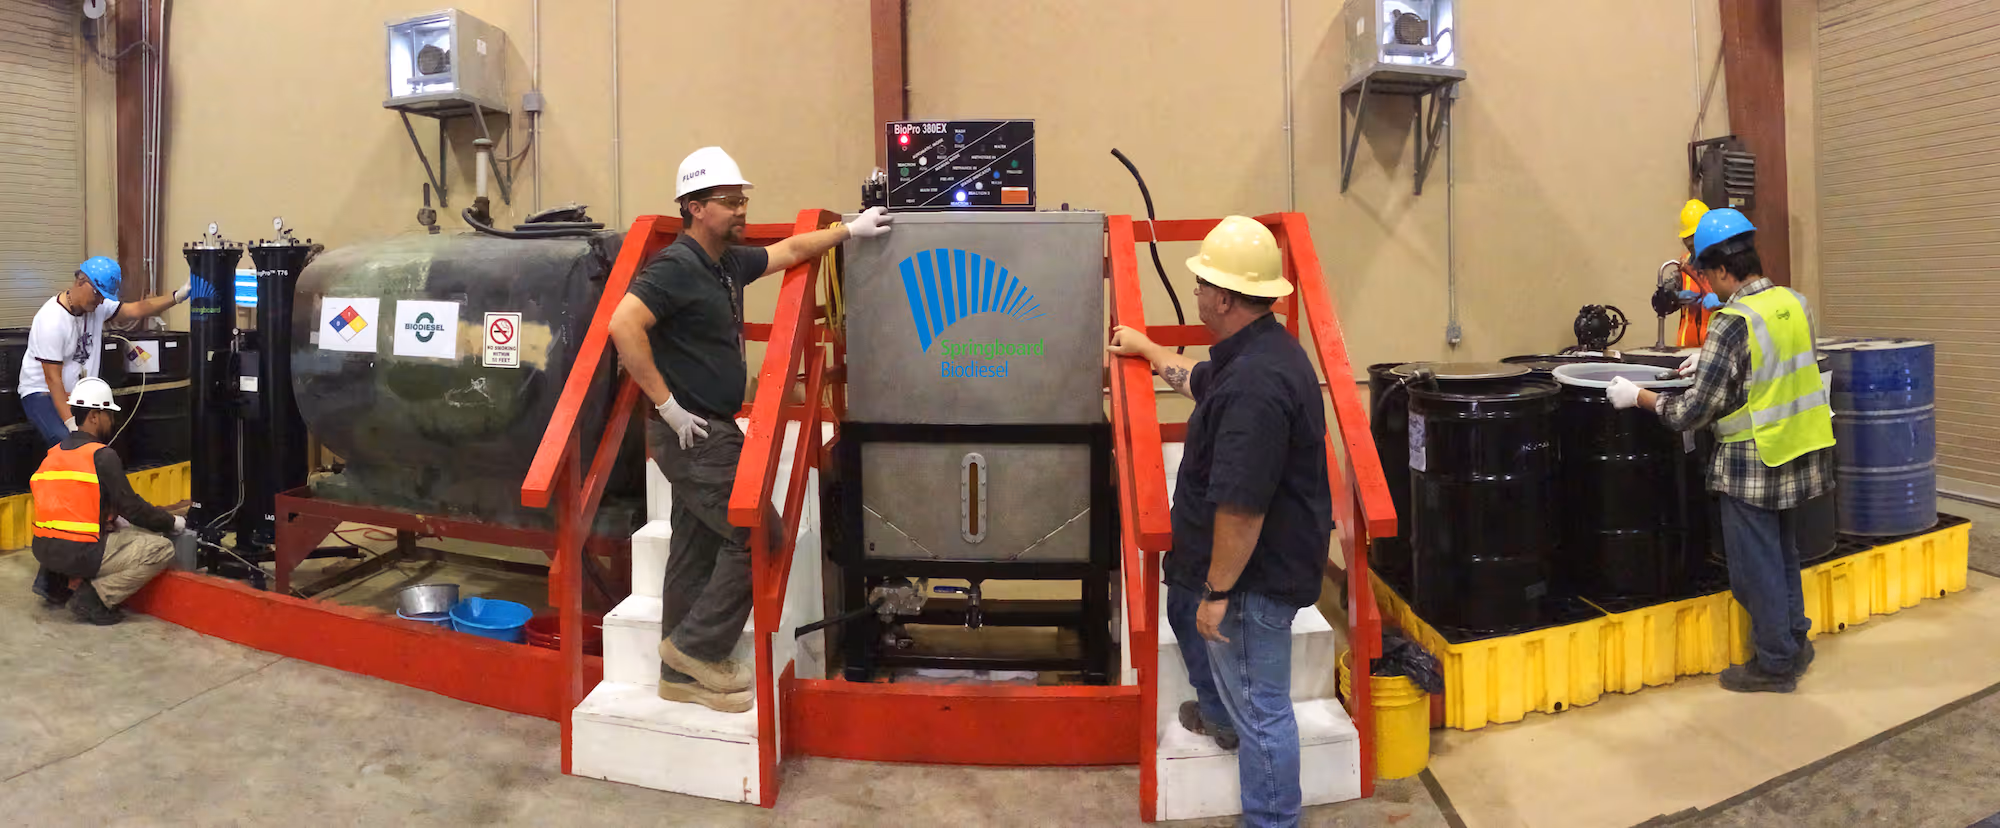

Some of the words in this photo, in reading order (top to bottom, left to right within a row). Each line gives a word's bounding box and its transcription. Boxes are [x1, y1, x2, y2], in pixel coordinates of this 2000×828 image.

[894, 124, 920, 134] BioPro
[922, 123, 947, 133] 380EX
[682, 168, 706, 182] FLUOR
[405, 323, 444, 331] BIODIESEL
[940, 338, 1043, 360] Springboard
[941, 360, 1008, 378] Biodiesel
[264, 513, 275, 521] LAG
